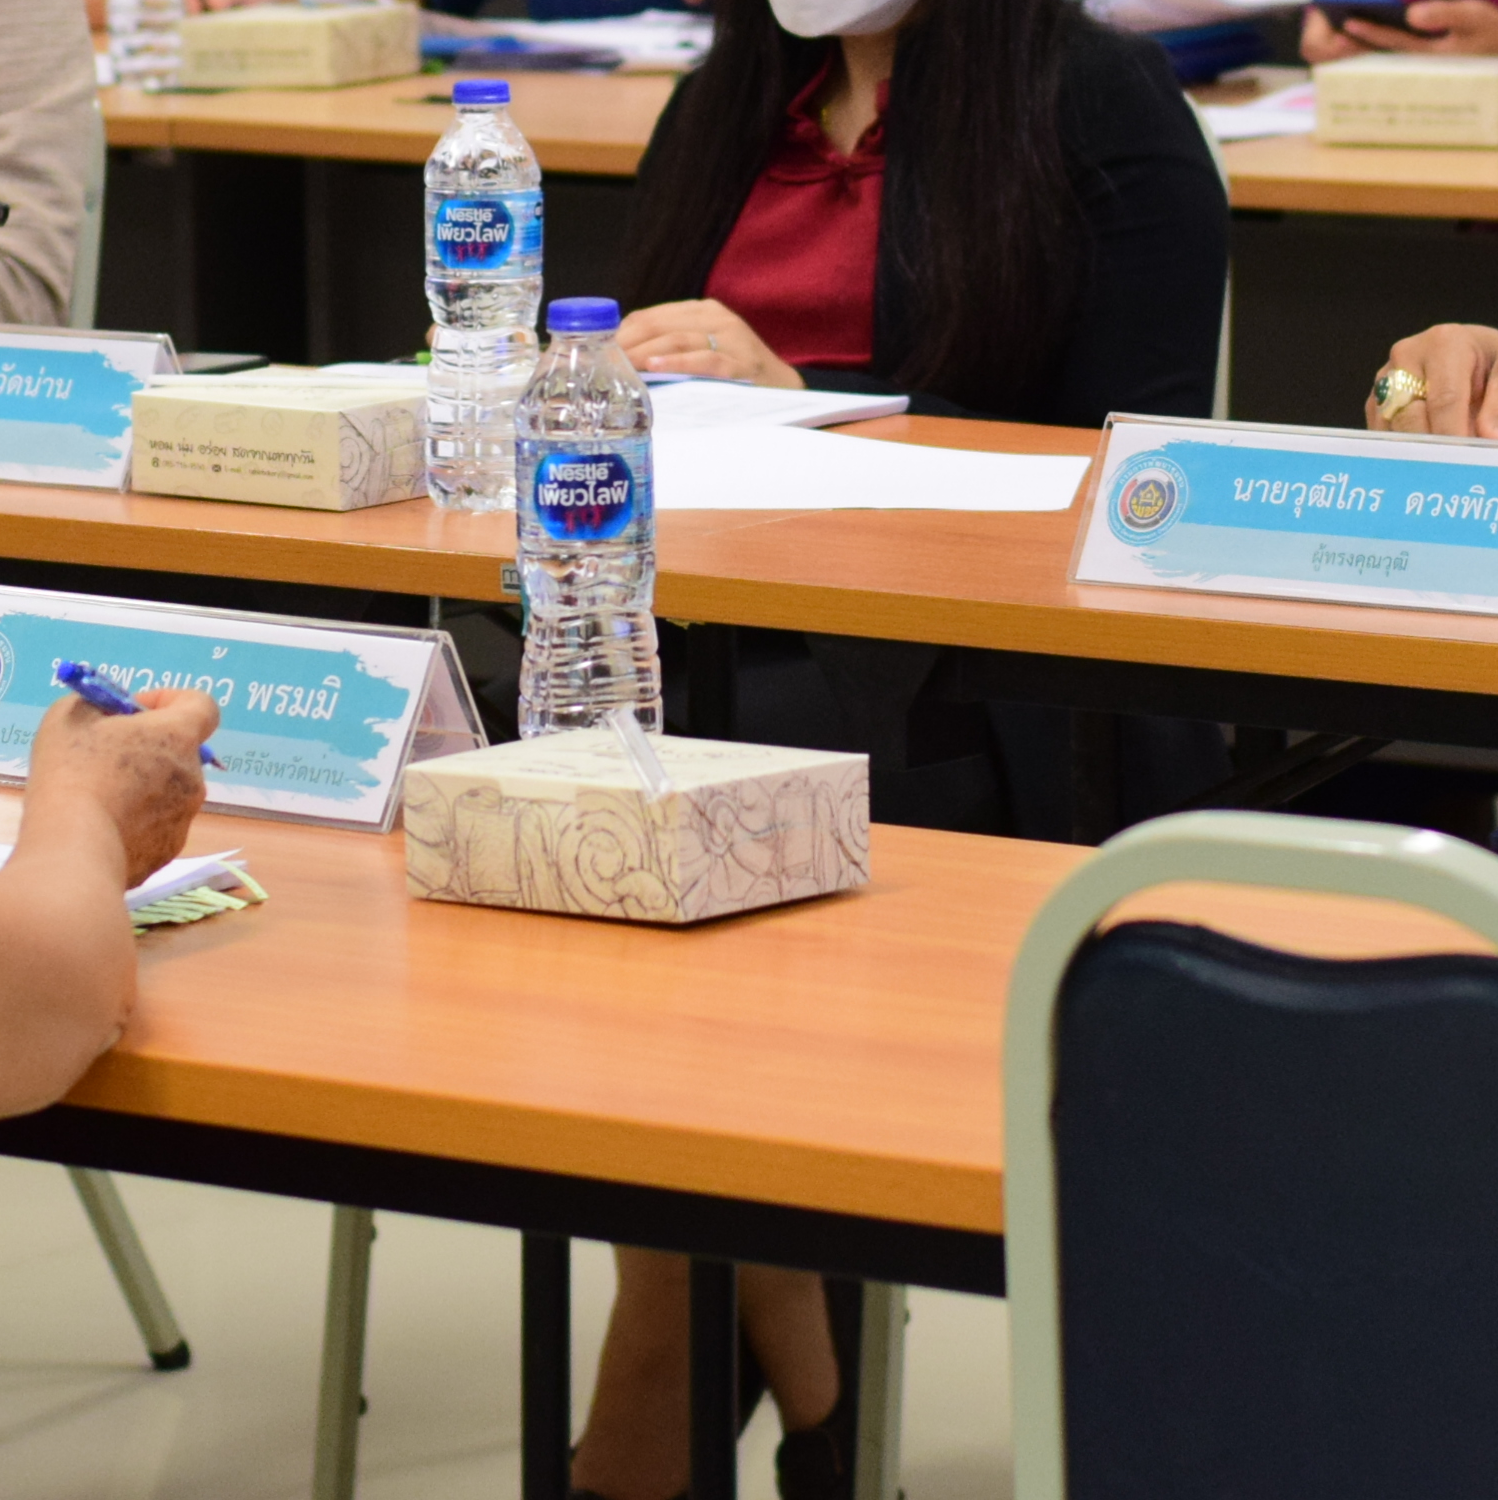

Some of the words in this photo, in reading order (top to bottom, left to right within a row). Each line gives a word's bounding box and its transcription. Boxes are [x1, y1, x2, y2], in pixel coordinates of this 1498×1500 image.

[198, 440, 227, 457] อร่อย
[1233, 472, 1384, 518] นายวุฒิไกร
[1311, 543, 1410, 577] ผู้ทรงคุณวุฒิ
[50, 646, 235, 706] นพวงแก้ว
[247, 675, 342, 721] พรมมิ
[1, 723, 38, 746] ประ
